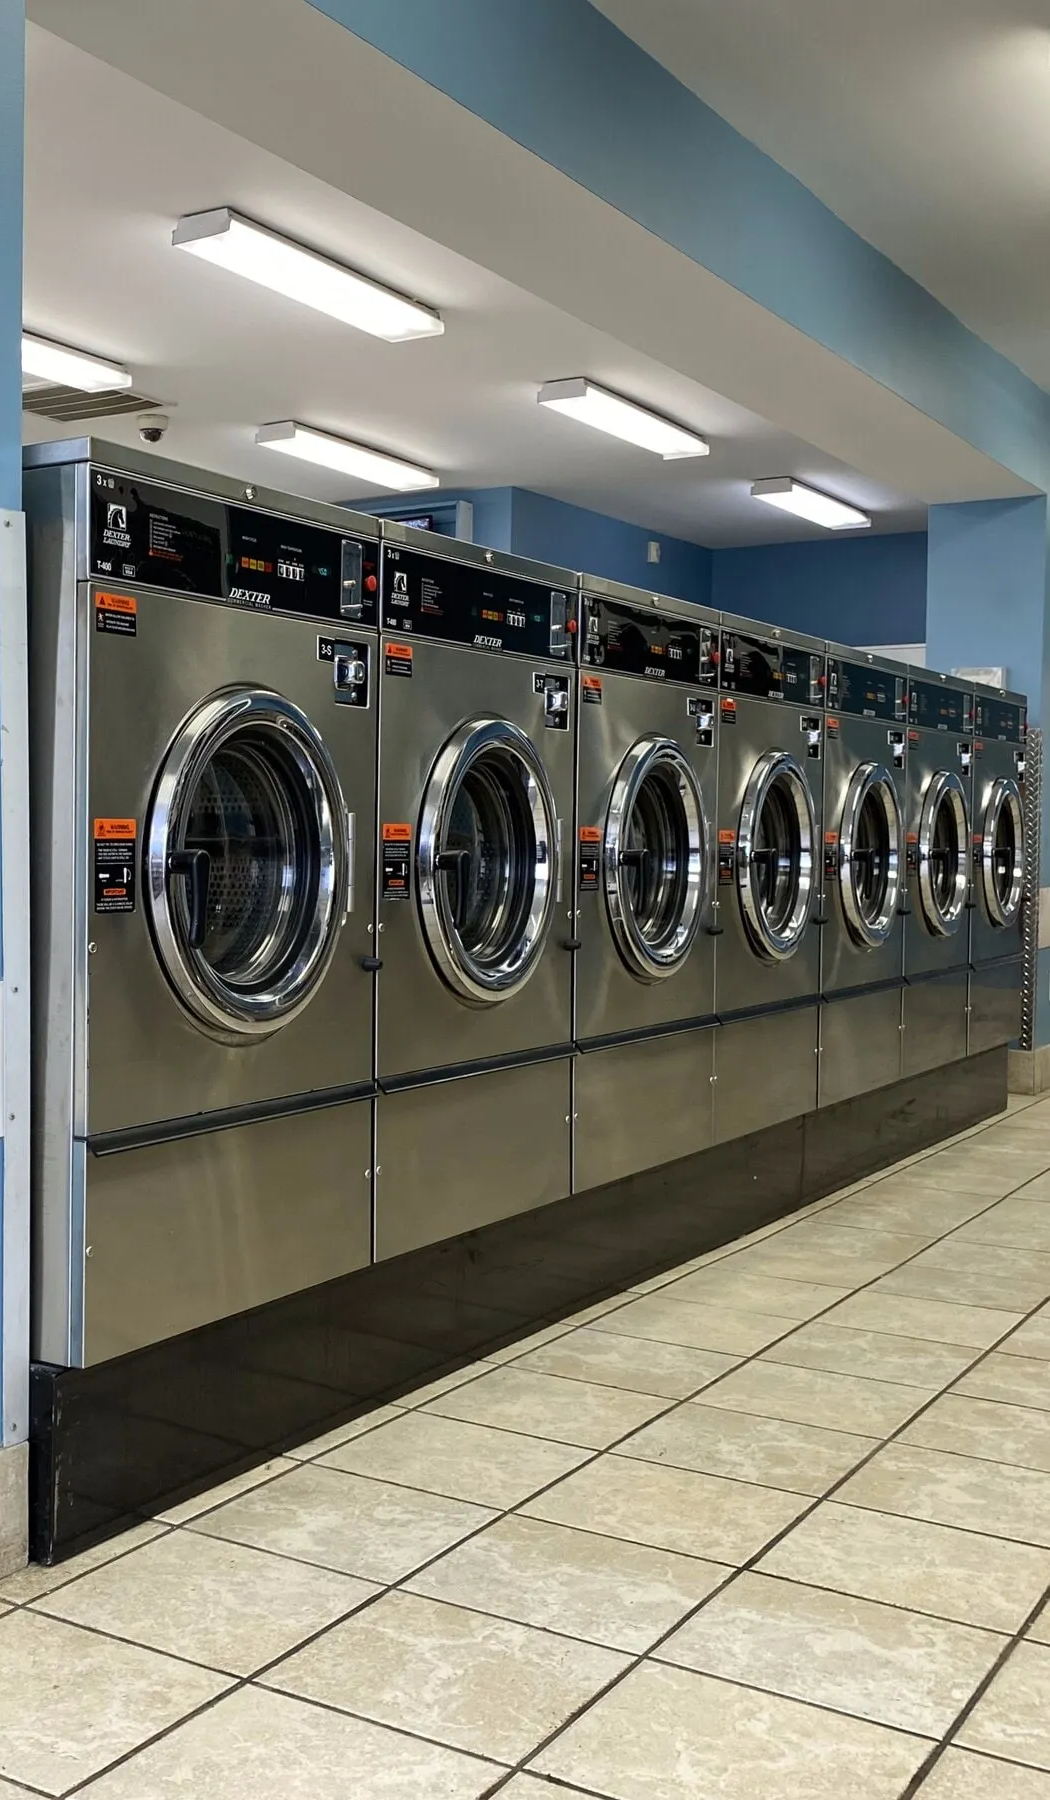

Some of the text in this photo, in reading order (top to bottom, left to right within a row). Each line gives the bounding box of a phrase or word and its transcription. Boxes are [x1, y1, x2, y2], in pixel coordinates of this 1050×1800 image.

[96, 474, 102, 486] 3
[103, 529, 131, 541] DEXTER
[387, 549, 392, 559] 3
[96, 560, 112, 571] T-400
[229, 587, 271, 605] DEXTER
[473, 634, 503, 648] DEXTER
[321, 644, 332, 656] 3-S
[536, 679, 544, 688] 3-T
